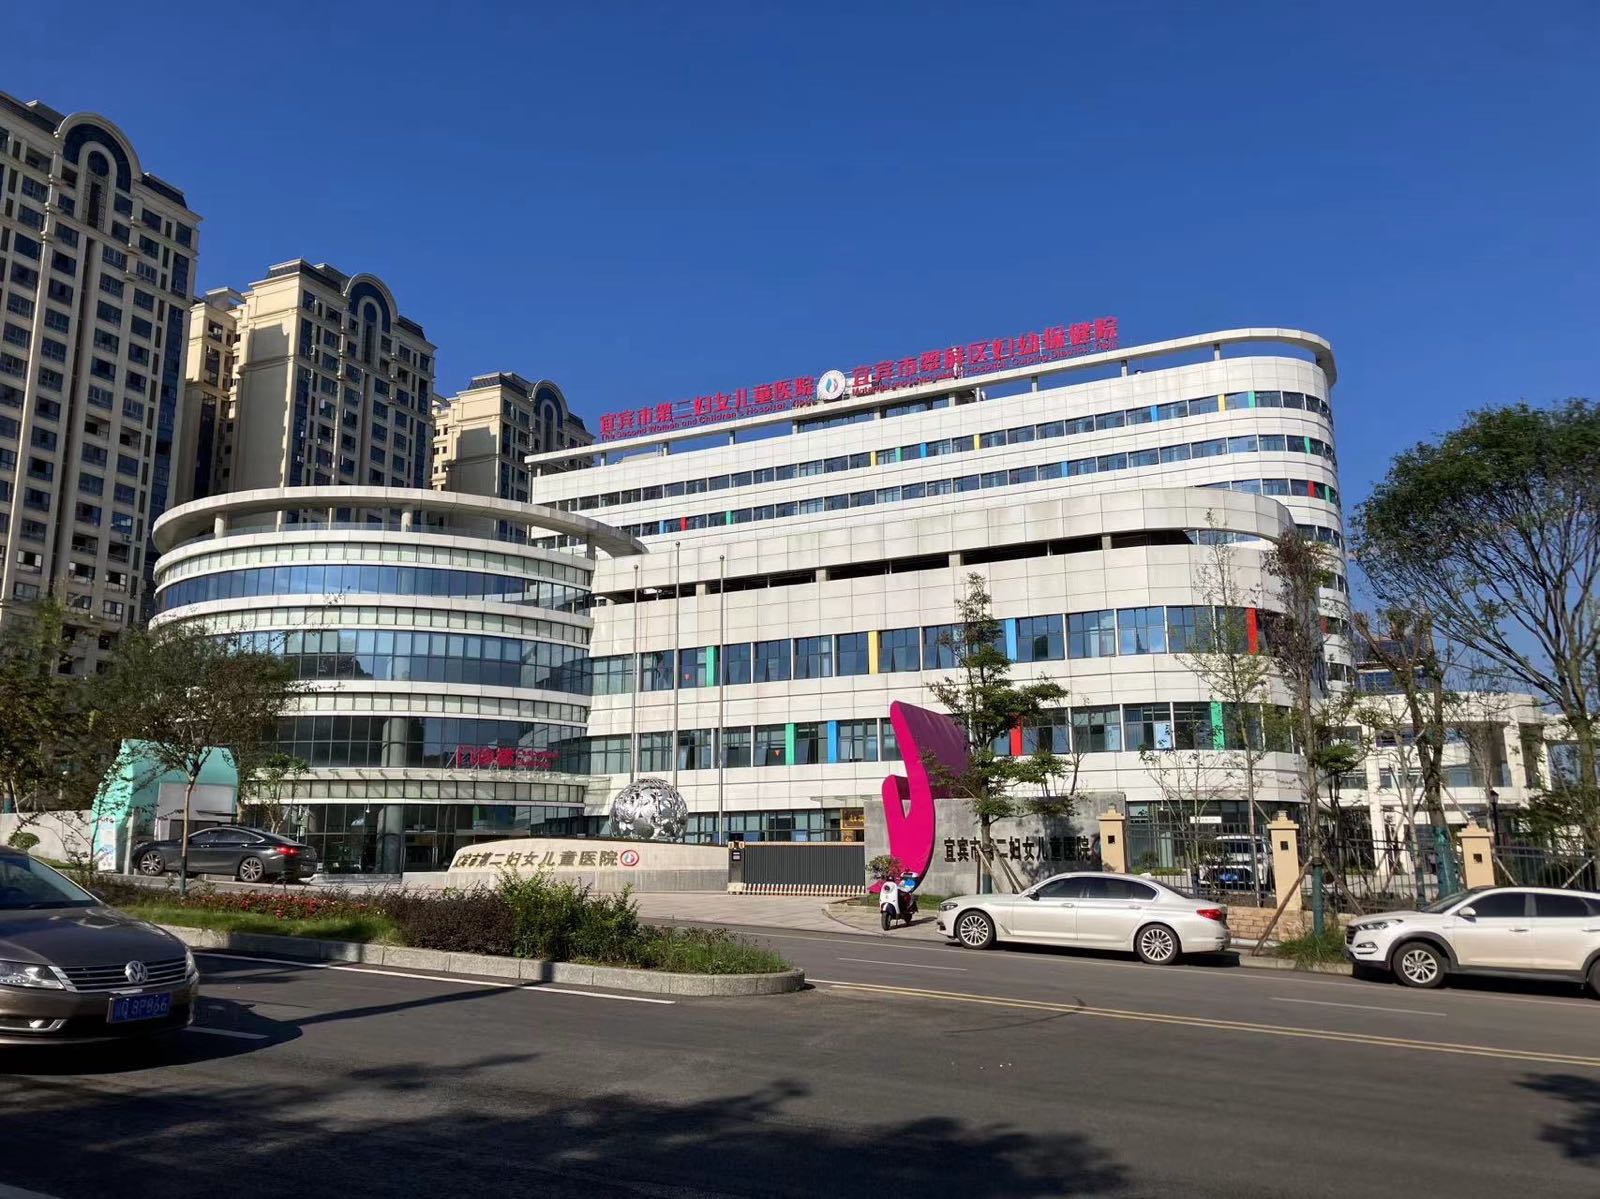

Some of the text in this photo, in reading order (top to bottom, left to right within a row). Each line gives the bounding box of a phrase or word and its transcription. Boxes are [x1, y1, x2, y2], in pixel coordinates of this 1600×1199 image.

[852, 316, 1118, 387] 宜宾市翠屏区妇幼保健院
[600, 376, 815, 433] 宜宾市第二妇女儿童医院
[944, 836, 1090, 862] 宜宾市二妇女儿童医院
